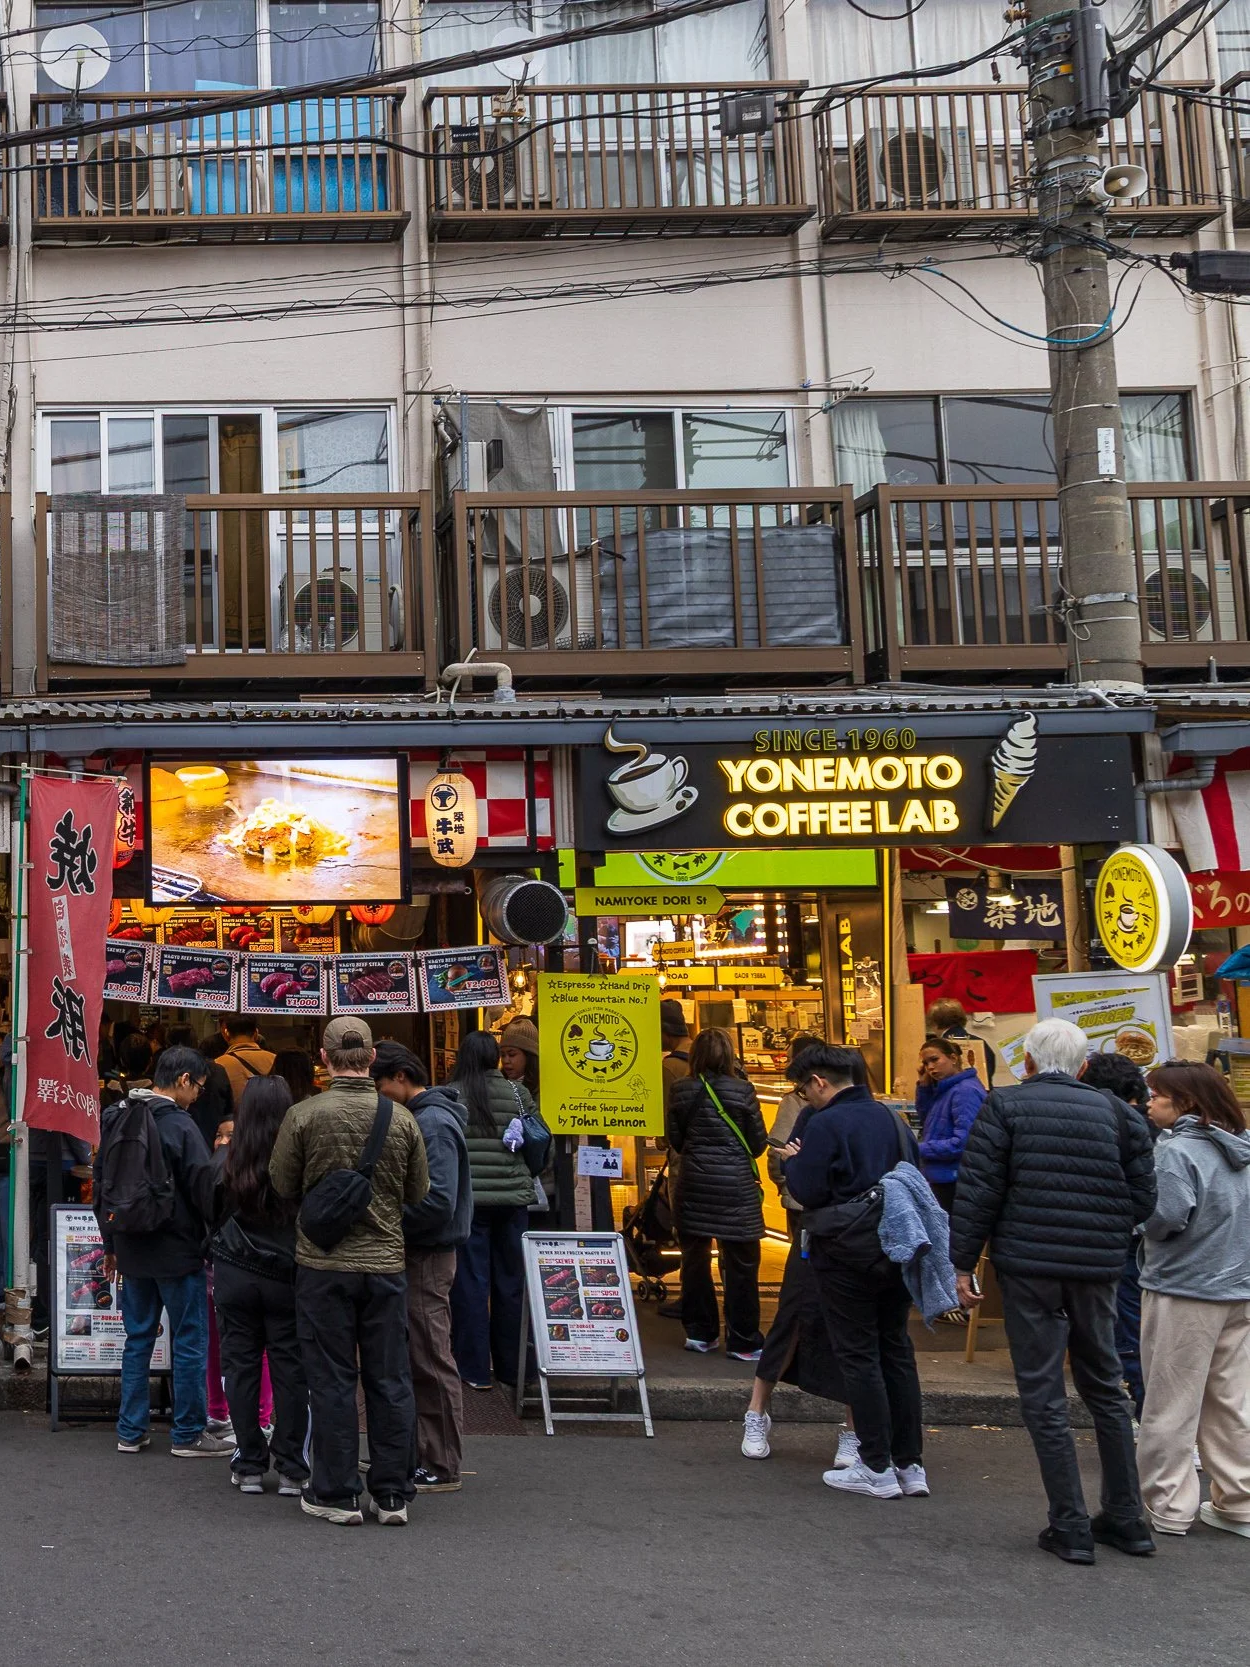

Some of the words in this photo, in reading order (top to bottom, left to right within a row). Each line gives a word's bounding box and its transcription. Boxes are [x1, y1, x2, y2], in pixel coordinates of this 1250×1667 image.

[754, 729, 838, 752] SINCE
[847, 727, 917, 750] 1960
[718, 755, 963, 793] YONEMOTO
[454, 811, 465, 834] 築地
[724, 801, 873, 837] COFFEE
[876, 799, 960, 834] LAB
[436, 818, 454, 854] 牛武
[1110, 867, 1142, 882] YONEMOTO
[595, 896, 658, 907] NAMIYOKE
[663, 895, 691, 906] DORI
[696, 895, 707, 905] St
[839, 918, 853, 970] LAB
[107, 983, 140, 993] ¥3,000
[466, 979, 499, 989] ¥2,000
[557, 980, 595, 989] Espresso
[608, 981, 630, 990] Hand
[633, 982, 651, 992] Drip
[196, 993, 228, 1001] ¥2,000
[376, 991, 408, 1000] ¥5,000
[560, 993, 579, 1002] Blue
[582, 995, 625, 1004] Mountain
[629, 996, 648, 1004] No.1
[286, 998, 318, 1007] ¥1,000
[578, 1013, 620, 1024] YONEMOTO
[1078, 1006, 1135, 1029] BURGER
[569, 1103, 597, 1111] Coffee
[600, 1104, 618, 1114] Shop
[621, 1104, 644, 1112] Loved
[558, 1115, 568, 1126] by
[570, 1115, 599, 1127] John
[604, 1117, 646, 1127] Lennon
